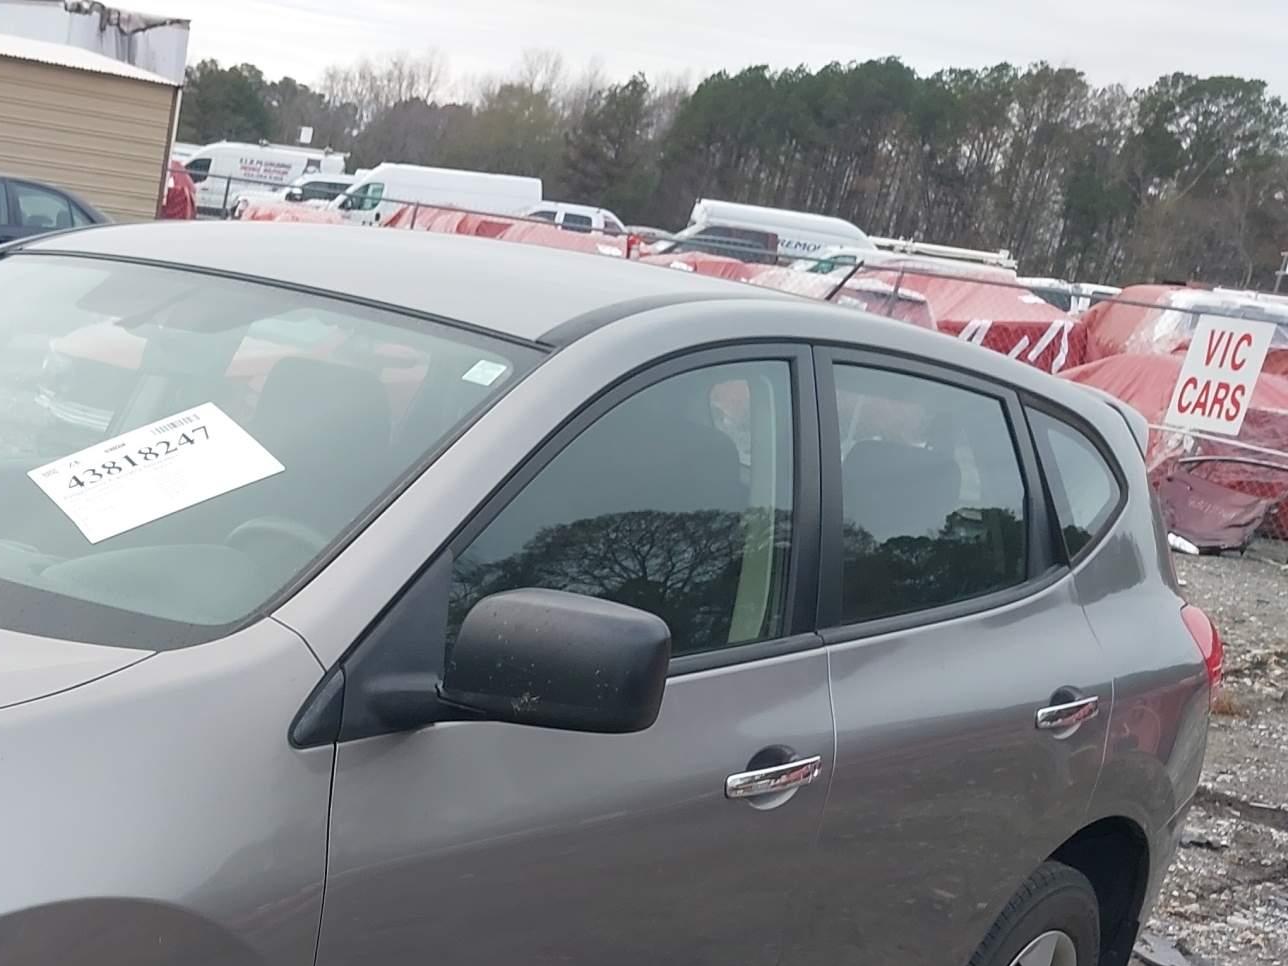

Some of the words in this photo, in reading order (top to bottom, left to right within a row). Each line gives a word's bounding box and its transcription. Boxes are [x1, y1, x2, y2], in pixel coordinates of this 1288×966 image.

[1205, 329, 1252, 371] VIC
[1177, 377, 1245, 421] CARS
[68, 425, 209, 489] 43818247
